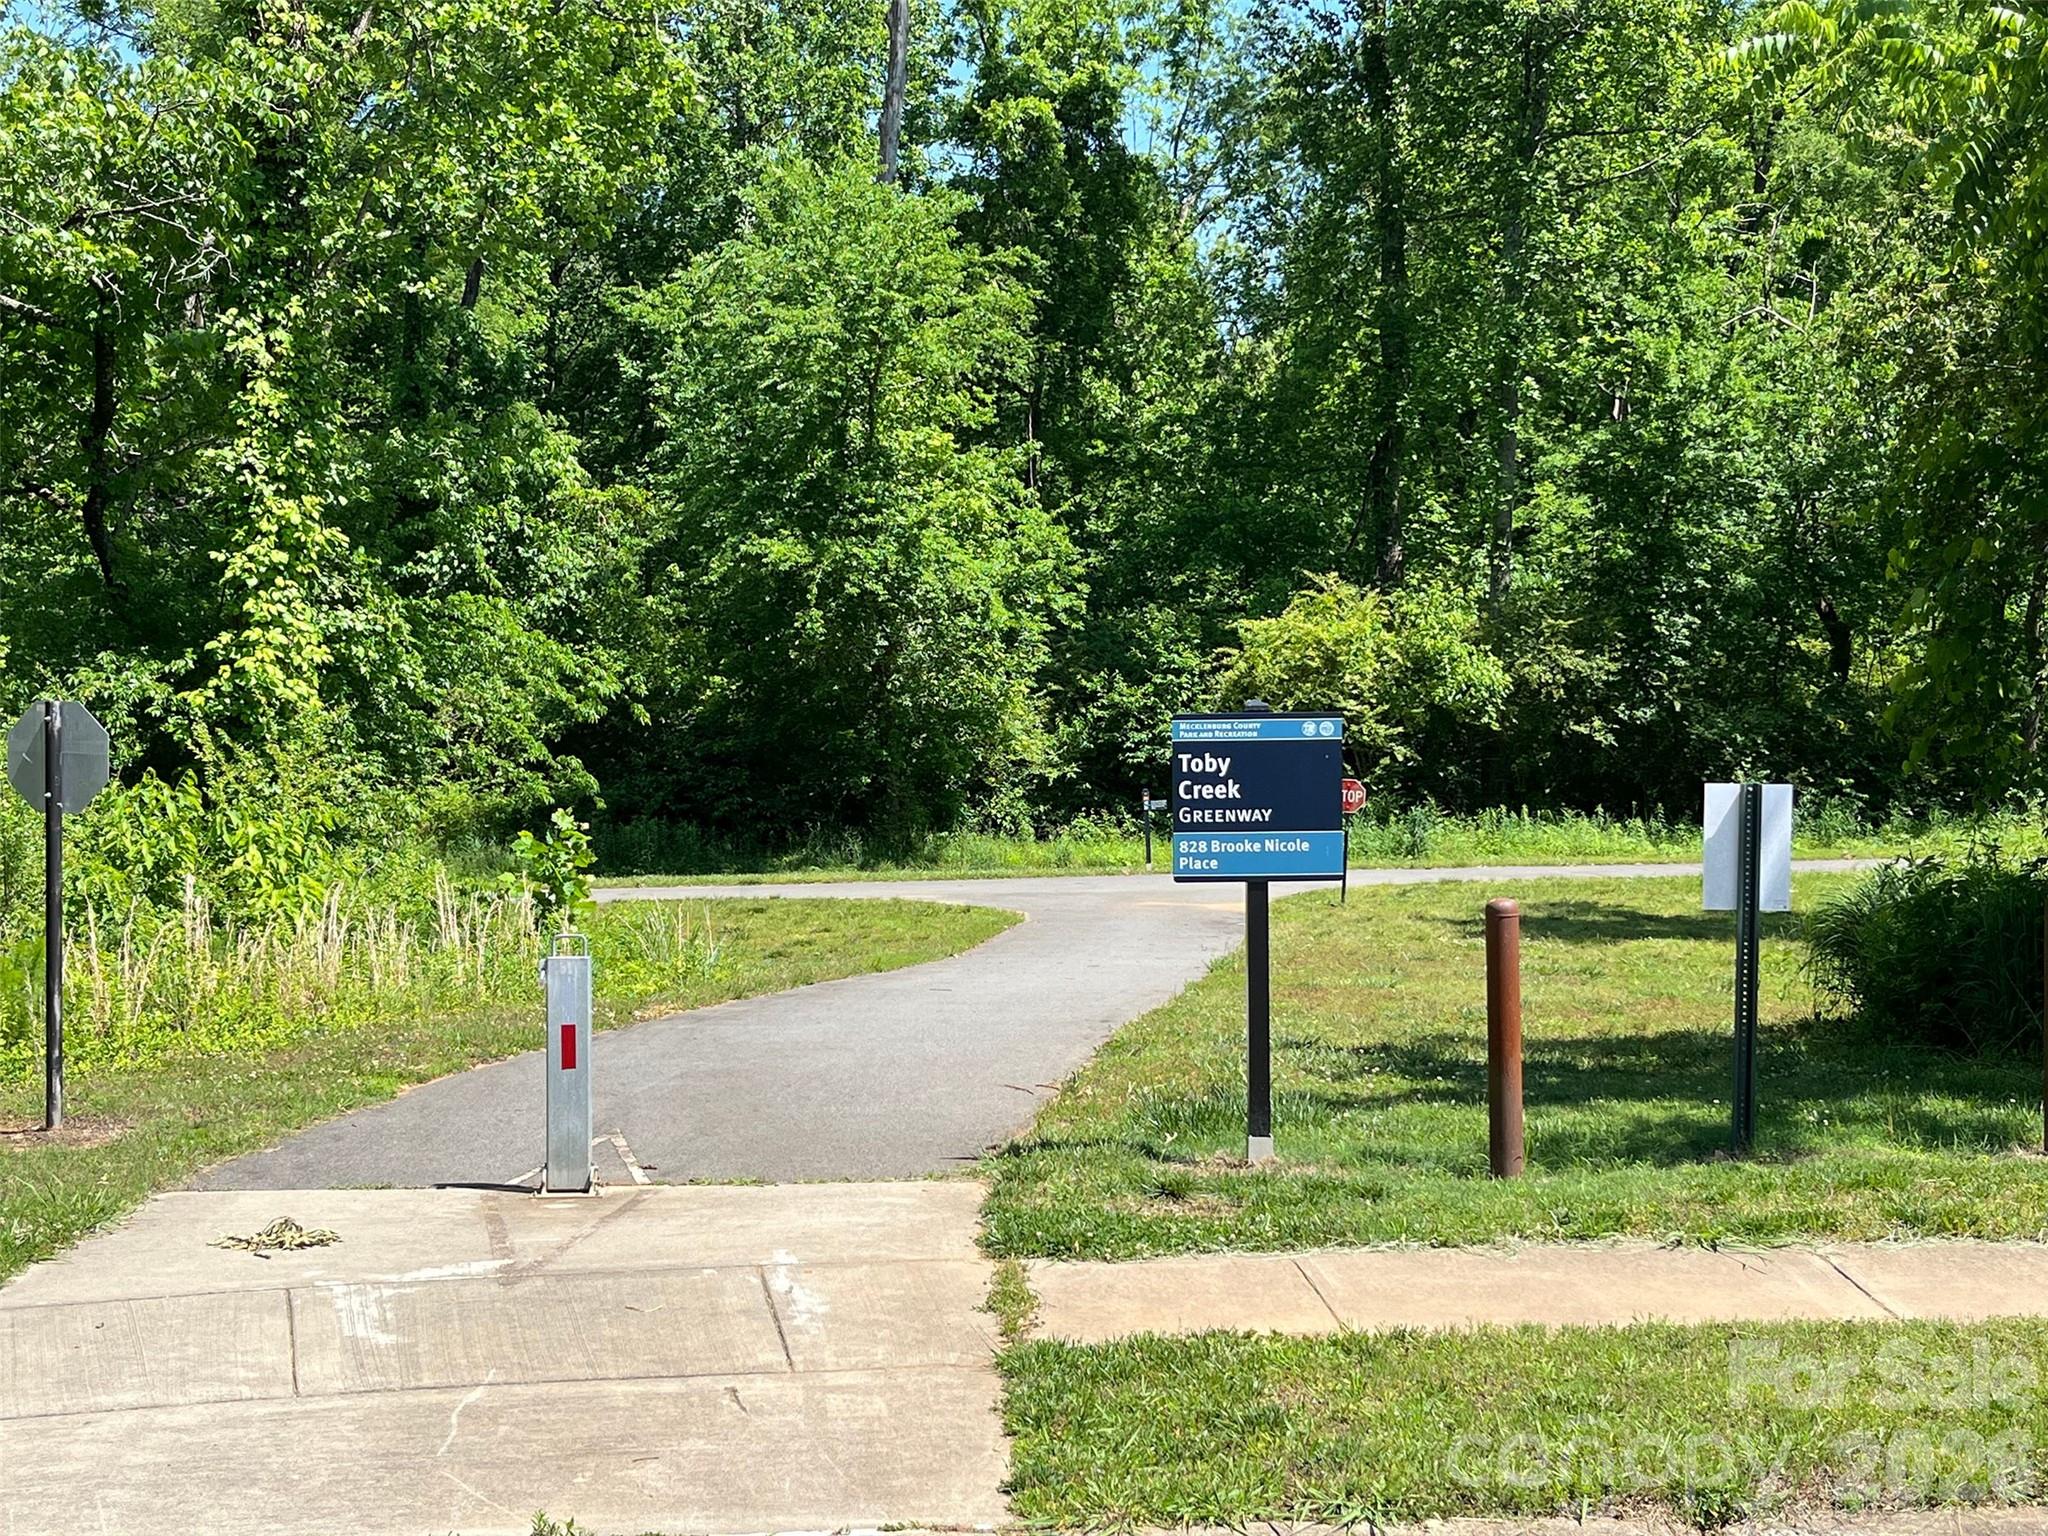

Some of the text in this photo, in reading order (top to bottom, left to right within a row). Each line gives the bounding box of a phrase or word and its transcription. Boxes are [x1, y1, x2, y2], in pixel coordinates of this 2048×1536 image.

[1179, 722, 1261, 730] MECKLENBURG COUNTY
[1214, 730, 1258, 738] RECREATION
[1178, 752, 1231, 777] Toby
[1178, 779, 1241, 800] Creek
[1342, 789, 1363, 803] TOP
[1179, 807, 1273, 824] GREENWAY
[1179, 838, 1310, 854] 828 Brooke Nicole
[1179, 856, 1218, 870] Place
